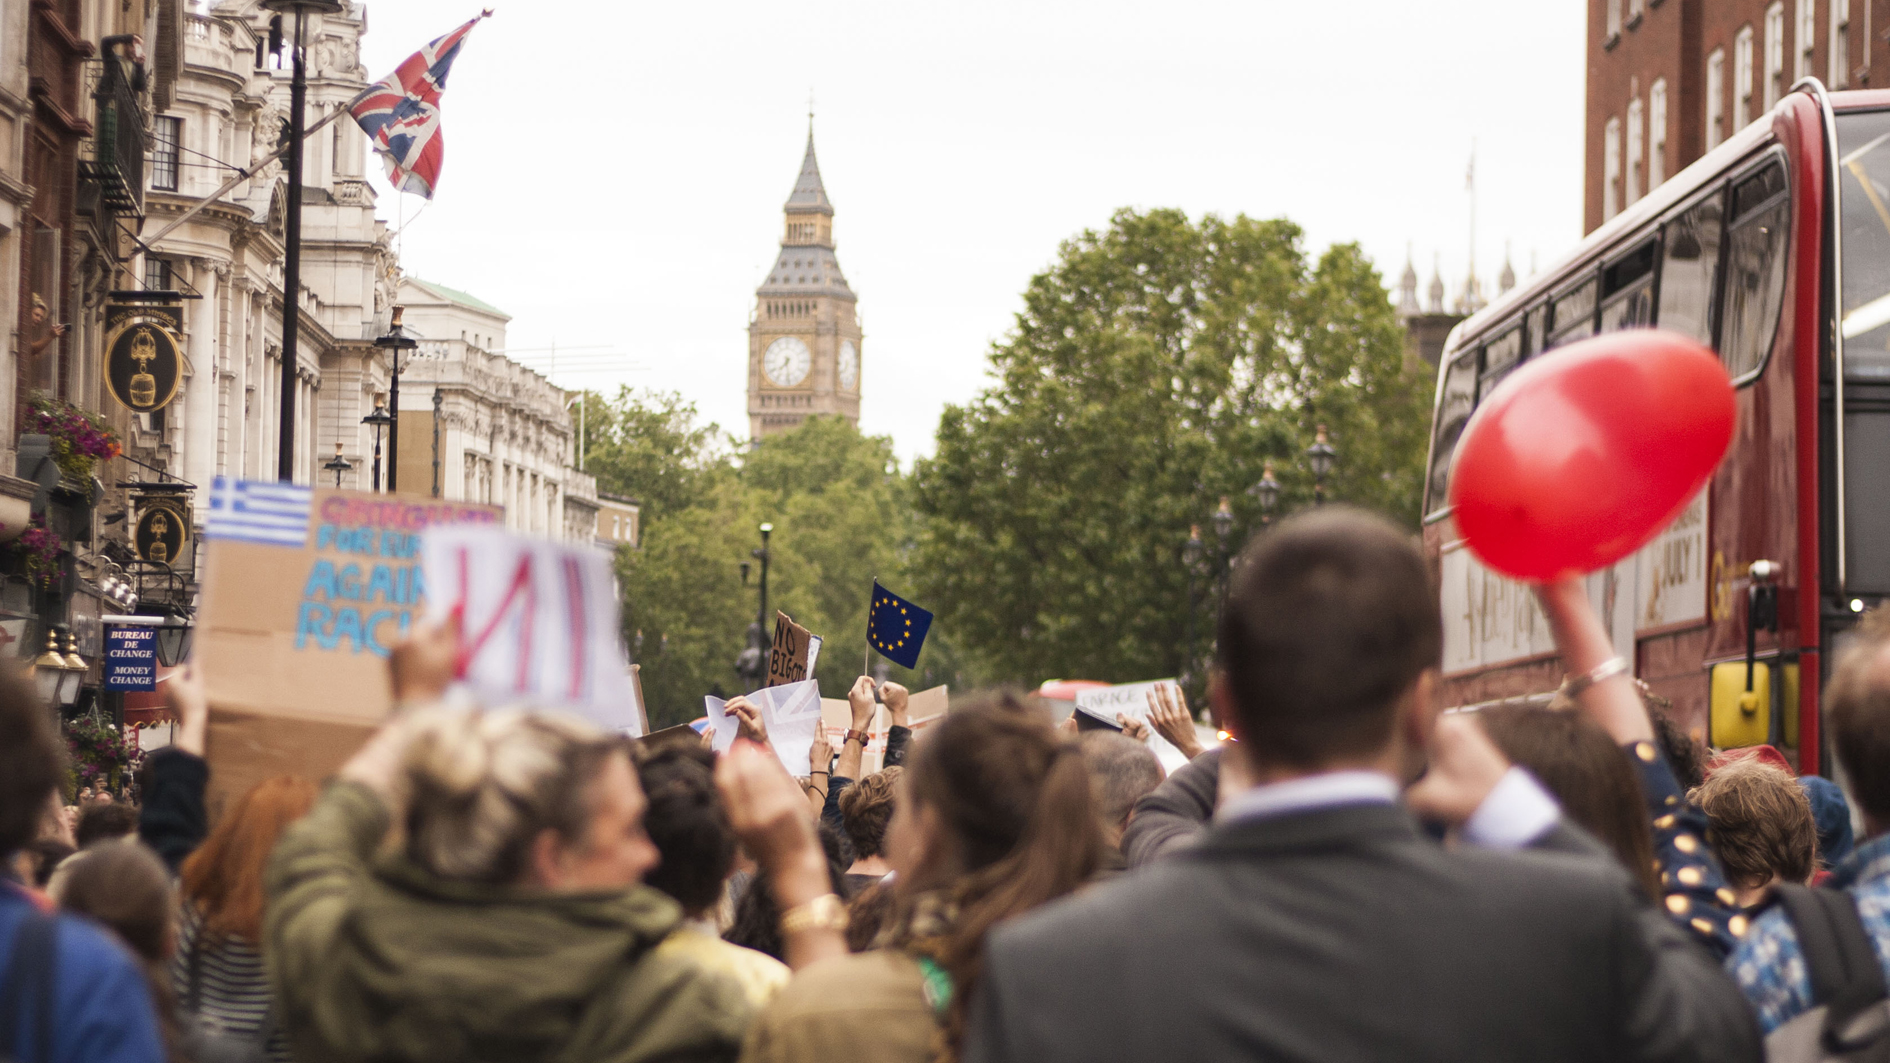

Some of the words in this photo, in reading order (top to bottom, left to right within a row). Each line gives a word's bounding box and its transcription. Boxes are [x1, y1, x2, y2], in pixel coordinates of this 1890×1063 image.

[317, 524, 375, 554] FOR
[1662, 534, 1691, 589] JULY
[111, 631, 154, 640] BUREAU
[773, 617, 796, 657] NO
[123, 640, 139, 649] DE
[110, 649, 153, 658] CHANGE
[114, 666, 151, 675] MONEY
[110, 676, 153, 685] CHANGE
